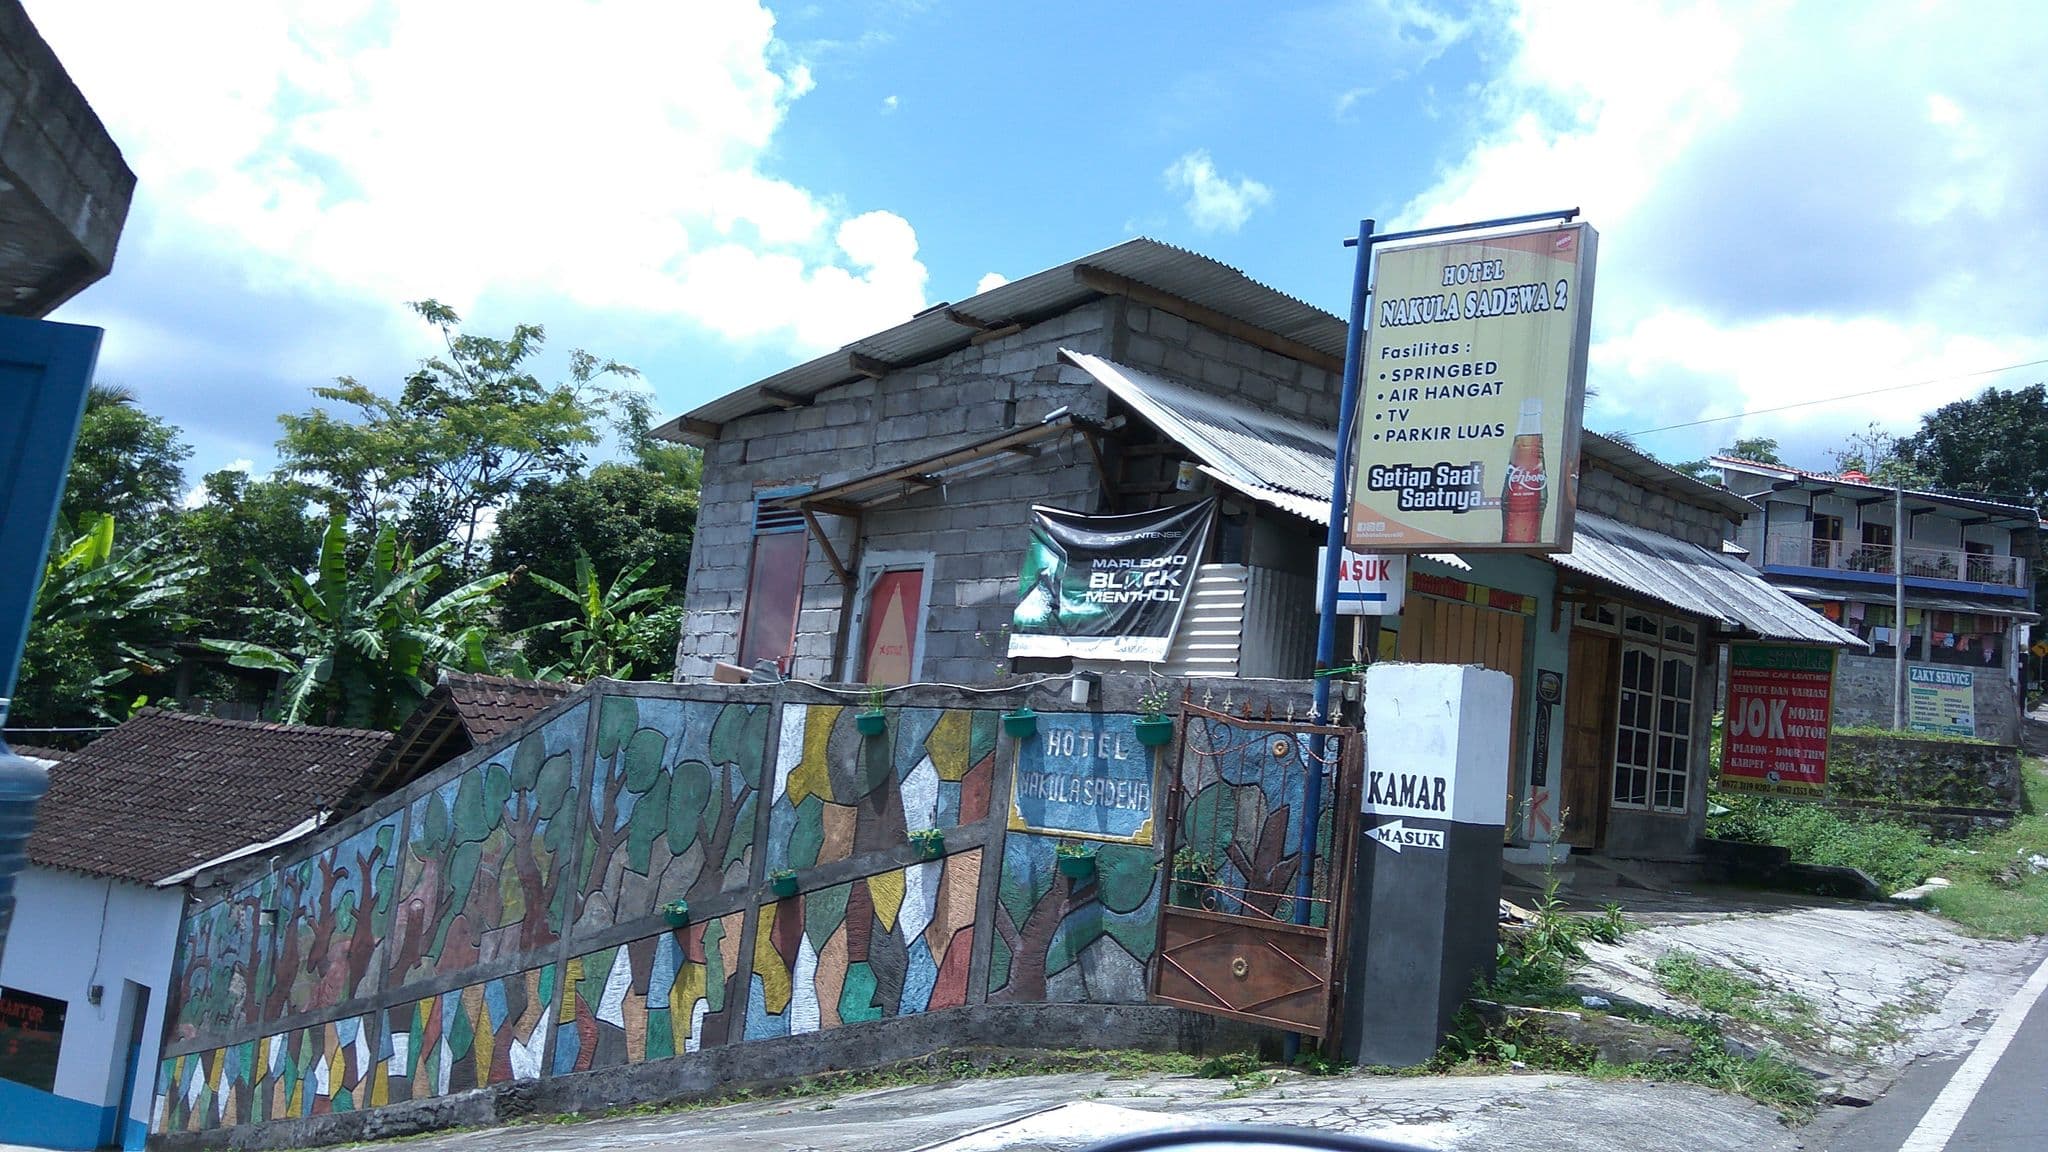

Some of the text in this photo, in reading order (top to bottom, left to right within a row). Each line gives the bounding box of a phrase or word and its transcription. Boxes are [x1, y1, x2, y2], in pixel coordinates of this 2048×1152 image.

[1442, 259, 1505, 287] HOTEL
[1380, 279, 1568, 327] NAKULA SADEWA 2
[1381, 343, 1459, 360] Fasilitas
[1391, 361, 1498, 382] SPRINGBED
[1389, 382, 1504, 403] AIR HANGAT
[1388, 408, 1410, 422] TV
[1386, 423, 1505, 443] PARKIR LUAS
[1371, 464, 1482, 490] Setiap Saat
[1338, 559, 1392, 581] ASUK
[1085, 588, 1181, 603] MENTHOL
[1911, 669, 1971, 685] ZAKY SERVICE
[1733, 684, 1828, 698] SERVICE DAN VARIASI
[1730, 697, 1787, 739] JOK
[1788, 707, 1826, 722] MOBIL
[1787, 724, 1827, 739] MOTOR
[1047, 728, 1129, 760] HOTEL
[1367, 771, 1447, 812] KAMAR
[1377, 828, 1441, 847] MASUK
